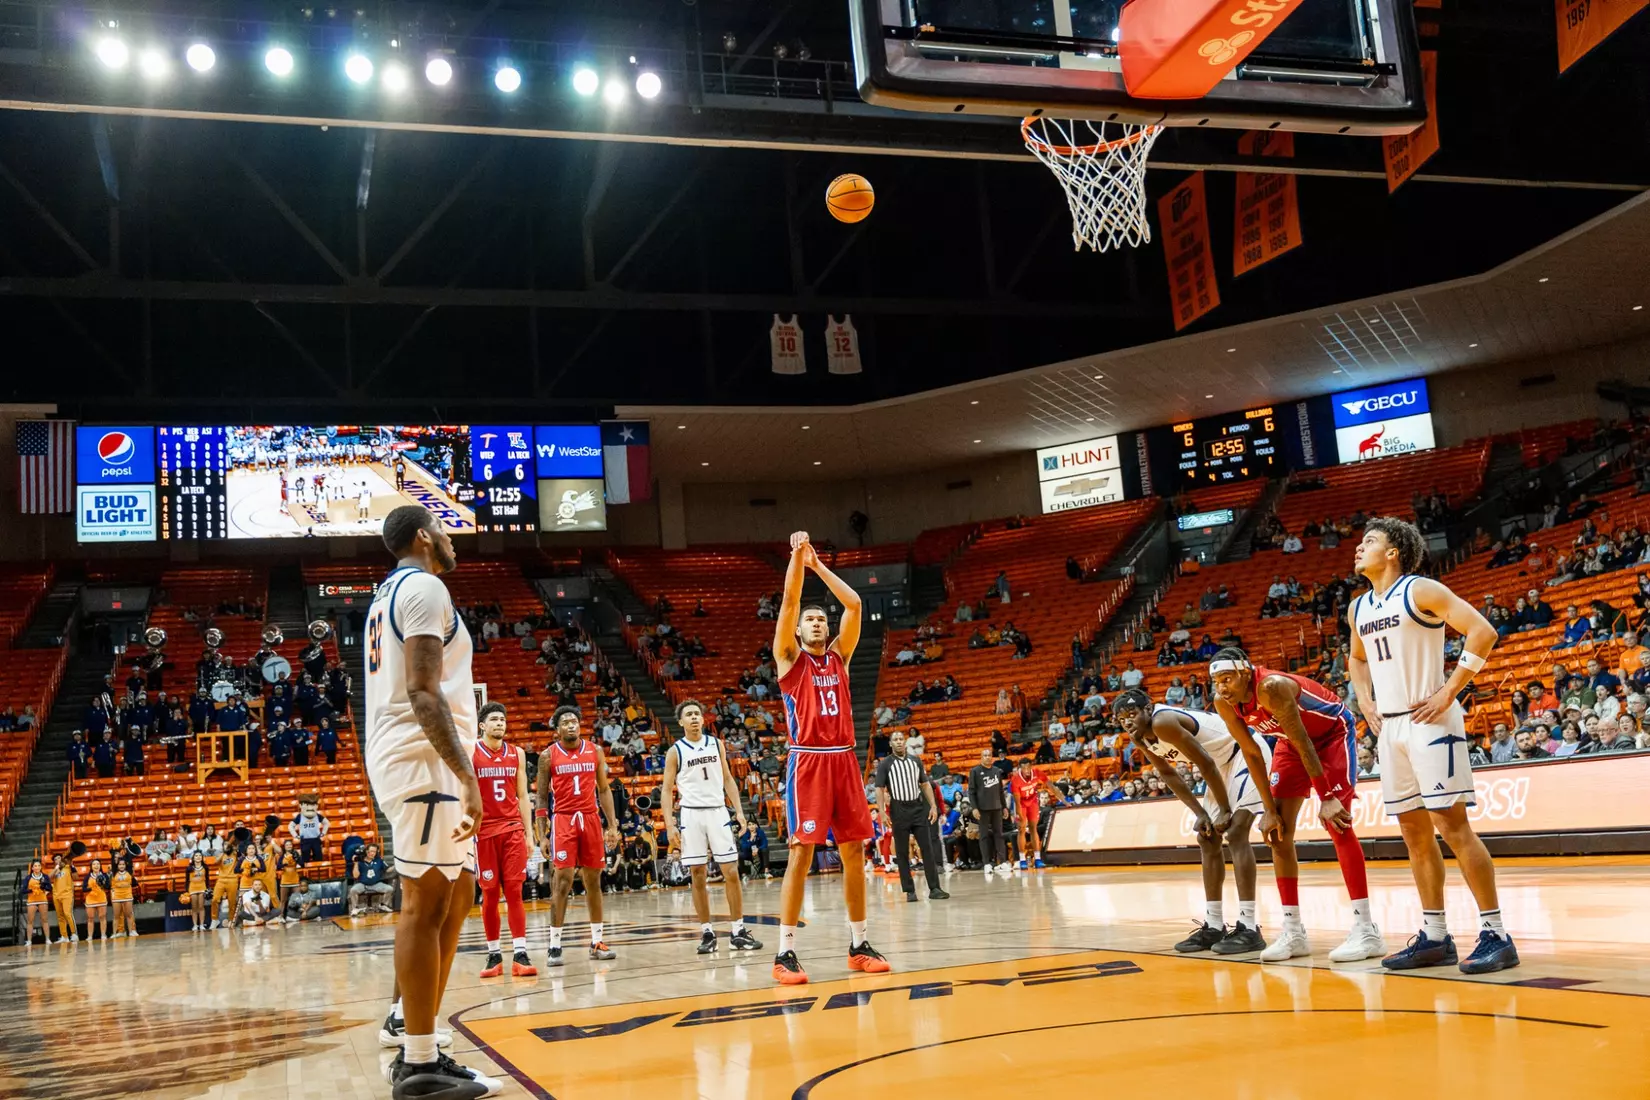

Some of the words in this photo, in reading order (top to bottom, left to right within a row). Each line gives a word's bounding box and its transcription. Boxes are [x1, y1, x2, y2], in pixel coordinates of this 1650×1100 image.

[779, 337, 796, 352] 10
[834, 337, 851, 352] 12
[1364, 391, 1418, 412] GECU
[1222, 427, 1227, 435] 1
[1229, 424, 1250, 433] PERIOD
[1264, 418, 1274, 432] 6
[1184, 432, 1194, 446] 6
[1384, 436, 1400, 446] BIG
[558, 446, 602, 456] WestStar
[1212, 439, 1244, 456] 12:55
[1256, 447, 1275, 456] FOULS
[1384, 442, 1416, 454] MEDIA
[1061, 446, 1112, 468] HUNT
[1268, 456, 1272, 464] 1
[102, 466, 132, 478] pepsi
[484, 464, 493, 480] 6
[515, 464, 524, 480] 6
[1180, 461, 1197, 470] FOULS
[1241, 468, 1248, 476] 4
[1188, 470, 1195, 478] 4
[488, 487, 521, 502] 12:55
[94, 496, 138, 508] BUD
[403, 480, 474, 528] MINERS
[1050, 493, 1117, 511] CHEVROLET
[86, 509, 147, 523] LIGHT
[492, 505, 503, 515] 1ST
[504, 505, 519, 515] Half
[177, 531, 182, 539] 3
[192, 531, 198, 539] 2
[1360, 614, 1400, 636] MINERS
[56, 636, 62, 644] Y
[369, 610, 383, 676] 32
[1374, 636, 1392, 662] 11
[819, 690, 839, 716] 13
[555, 764, 582, 775] LOUISIANA
[582, 762, 595, 772] TECH
[687, 756, 717, 767] MINERS
[478, 767, 505, 778] LOUISIANA
[702, 767, 709, 780] 1
[493, 780, 506, 802] 5
[573, 775, 581, 796] 1
